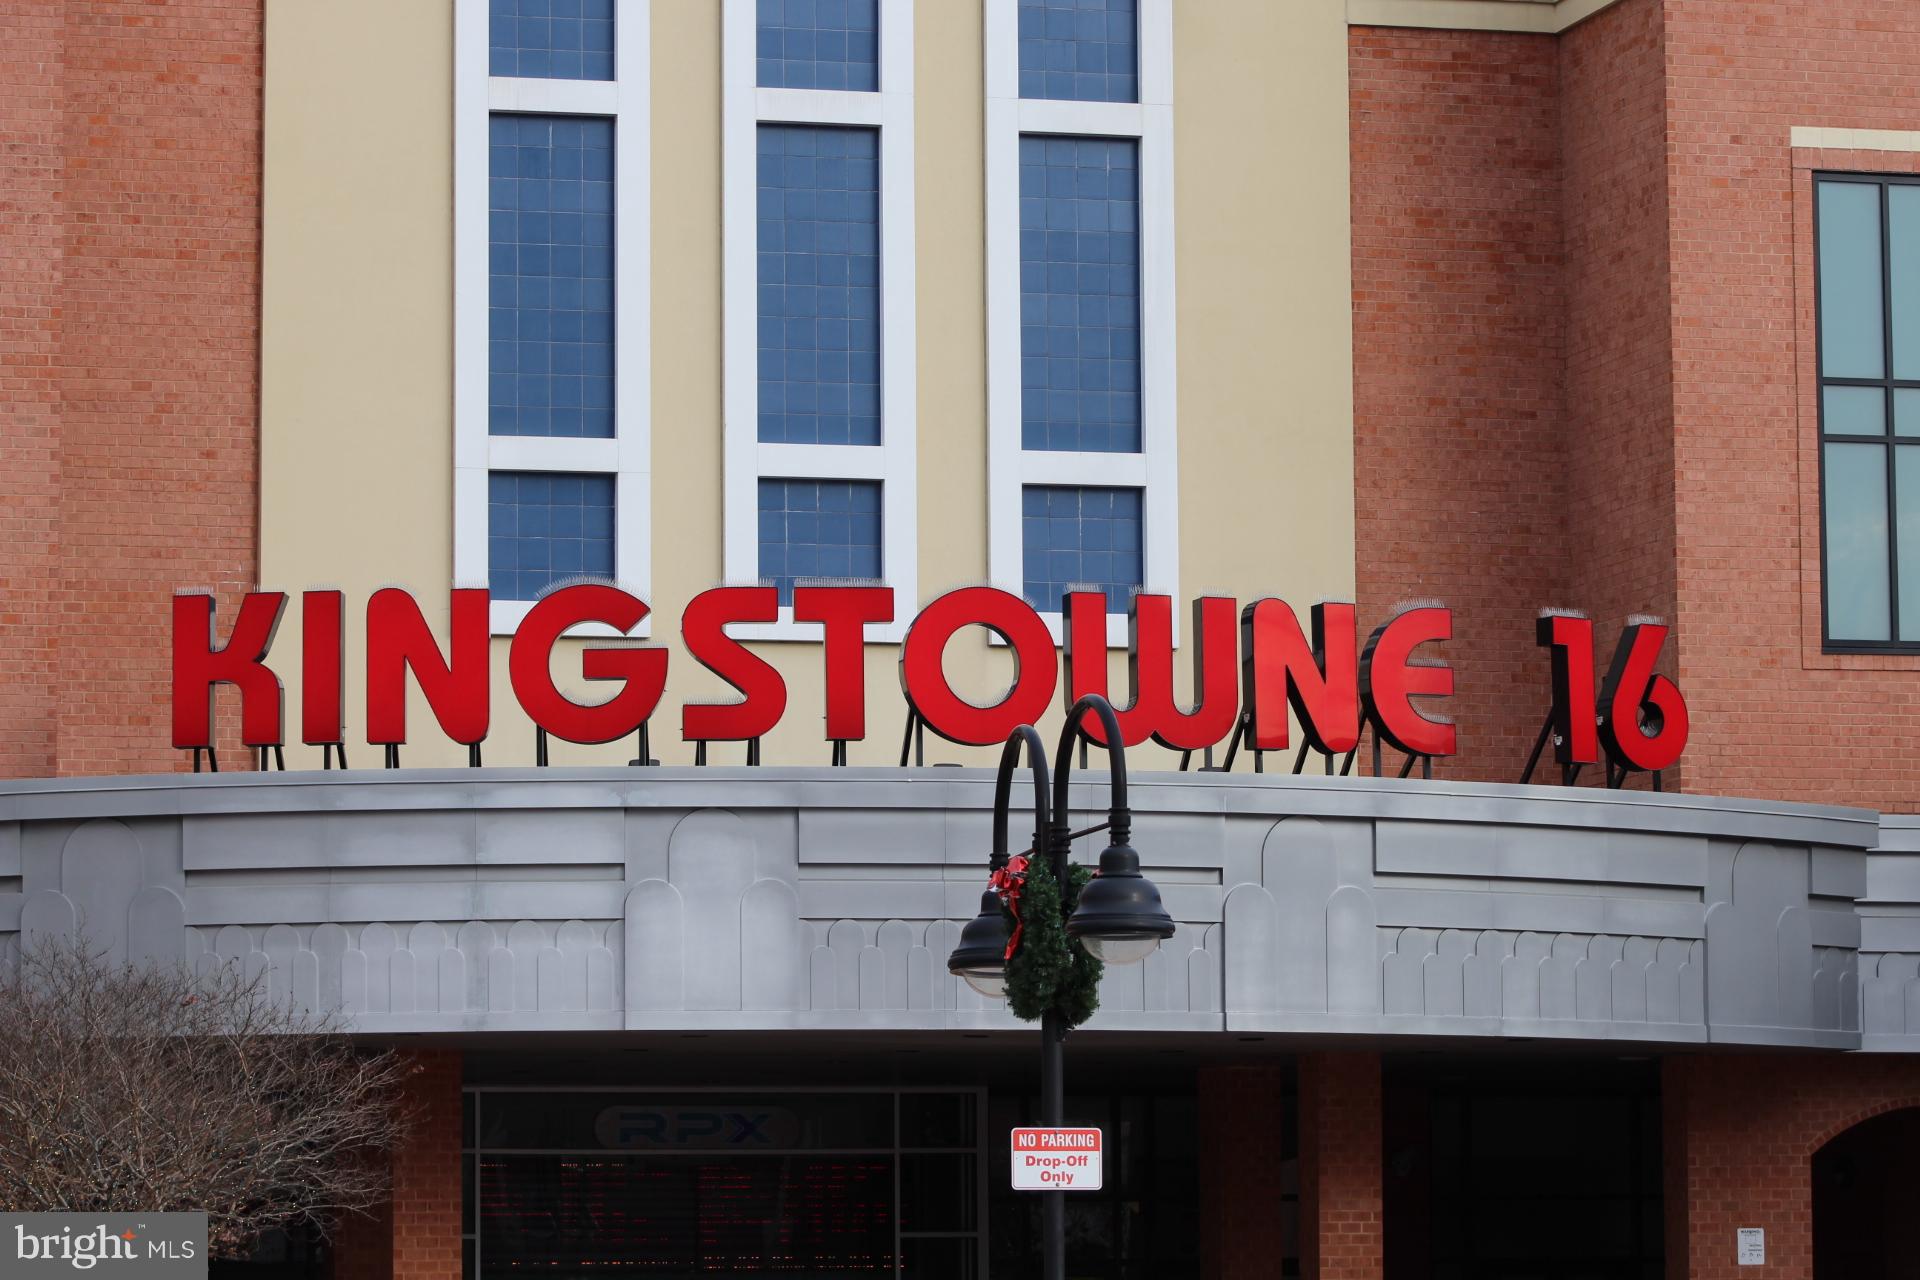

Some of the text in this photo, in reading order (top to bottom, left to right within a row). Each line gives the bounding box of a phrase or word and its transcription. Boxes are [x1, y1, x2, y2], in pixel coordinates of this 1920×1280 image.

[172, 584, 1688, 771] KINGSTOWNE 16
[619, 1112, 772, 1143] RPX
[1019, 1133, 1095, 1147] NO PARKING
[1025, 1155, 1088, 1169] Drop-Off
[1040, 1171, 1074, 1184] Only
